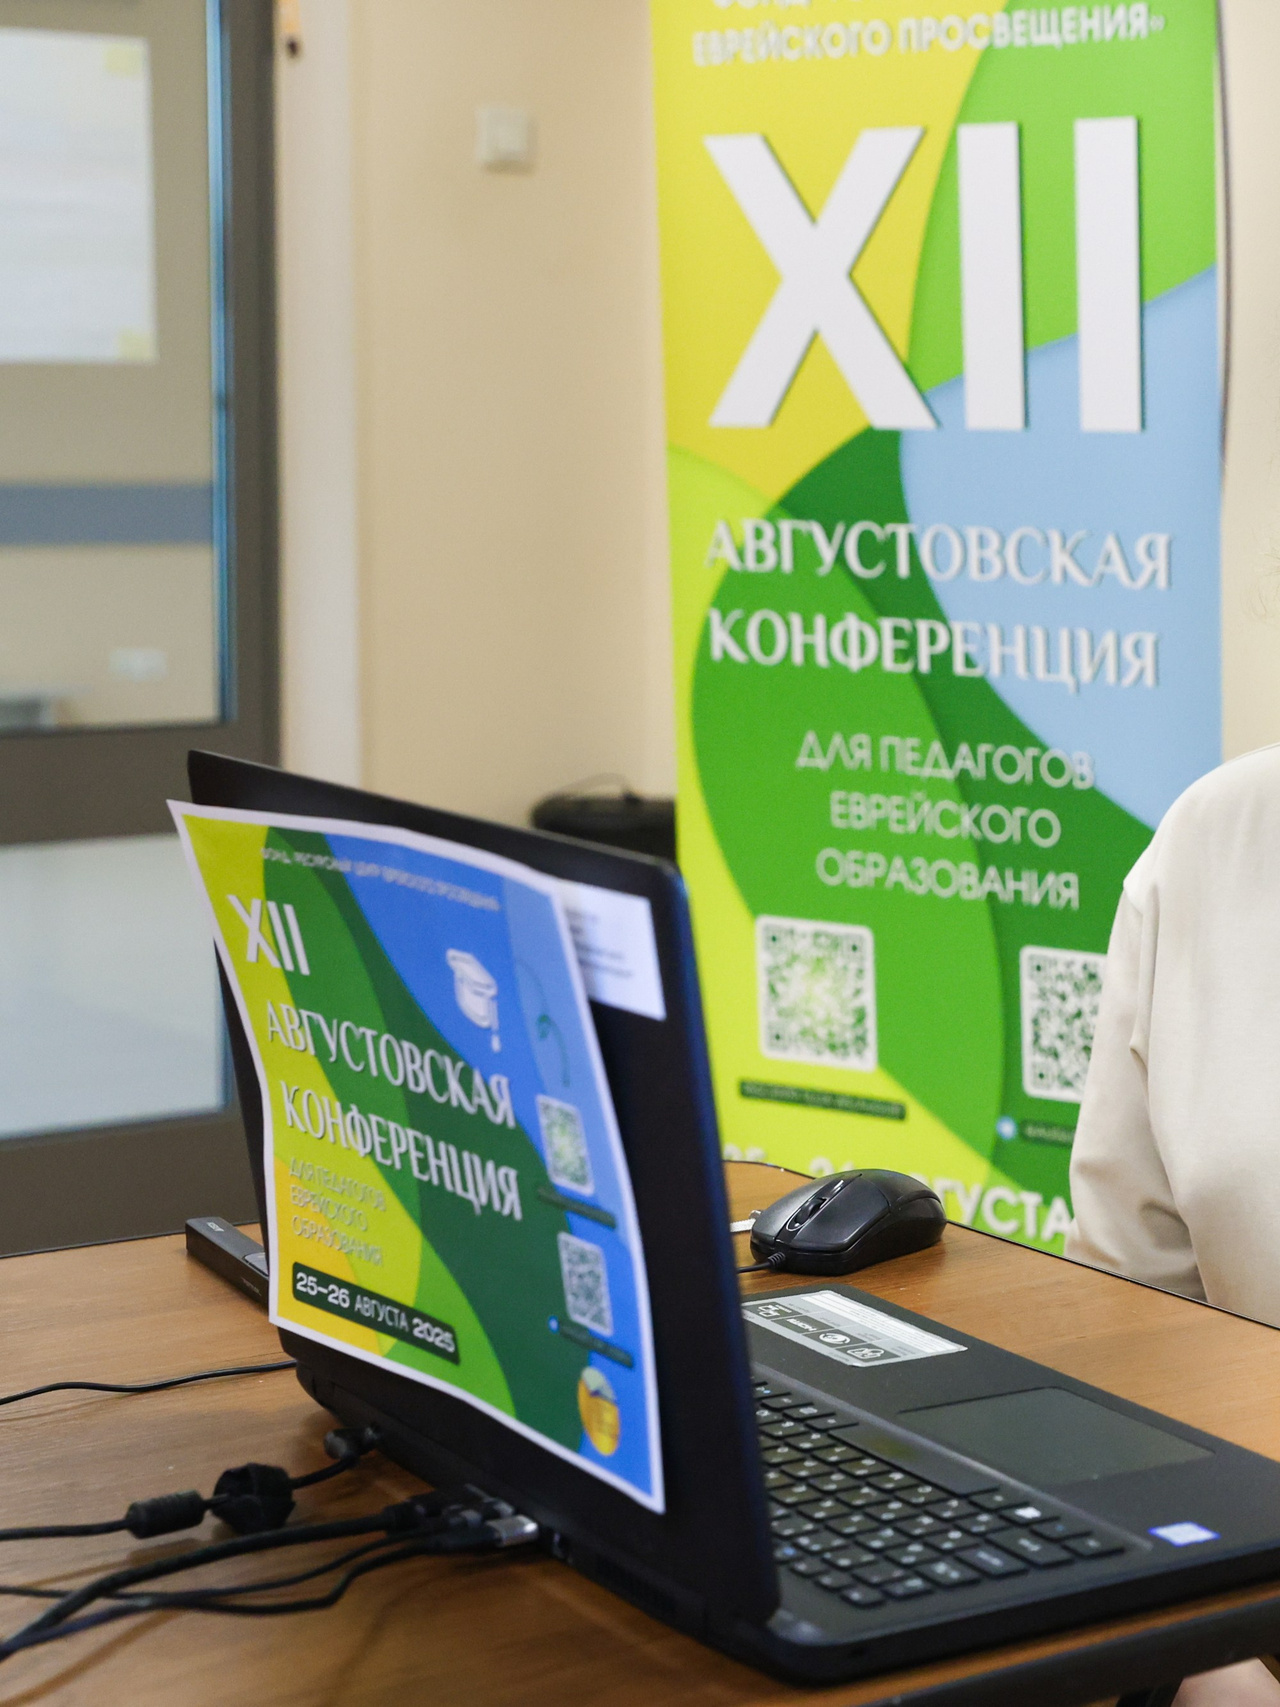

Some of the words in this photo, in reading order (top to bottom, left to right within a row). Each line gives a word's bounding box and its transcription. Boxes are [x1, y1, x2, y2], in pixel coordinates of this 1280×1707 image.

[692, 19, 892, 67] ЕВРЕЙСКОГО
[702, 116, 1145, 432] XII
[704, 518, 1173, 591] АВГУСТОВСКАЯ
[708, 606, 1160, 694] КОНФЕРЕНЦИЯ
[796, 729, 872, 772] ДЛЯ
[879, 734, 1096, 790] ПЕДАГОГОВ
[829, 790, 1062, 849] ЕВРЕЙСКОГО
[814, 847, 1080, 911] ОБРАЗОВАНИЯ
[227, 894, 311, 976] XII
[265, 999, 516, 1129] АВГУСТОВСКАЯ
[280, 1080, 523, 1221] КОНФЕРЕНЦИЯ
[910, 1173, 1076, 1243] ГУСТА
[354, 1294, 410, 1332] АВГУСТА
[412, 1316, 456, 1353] 2025
